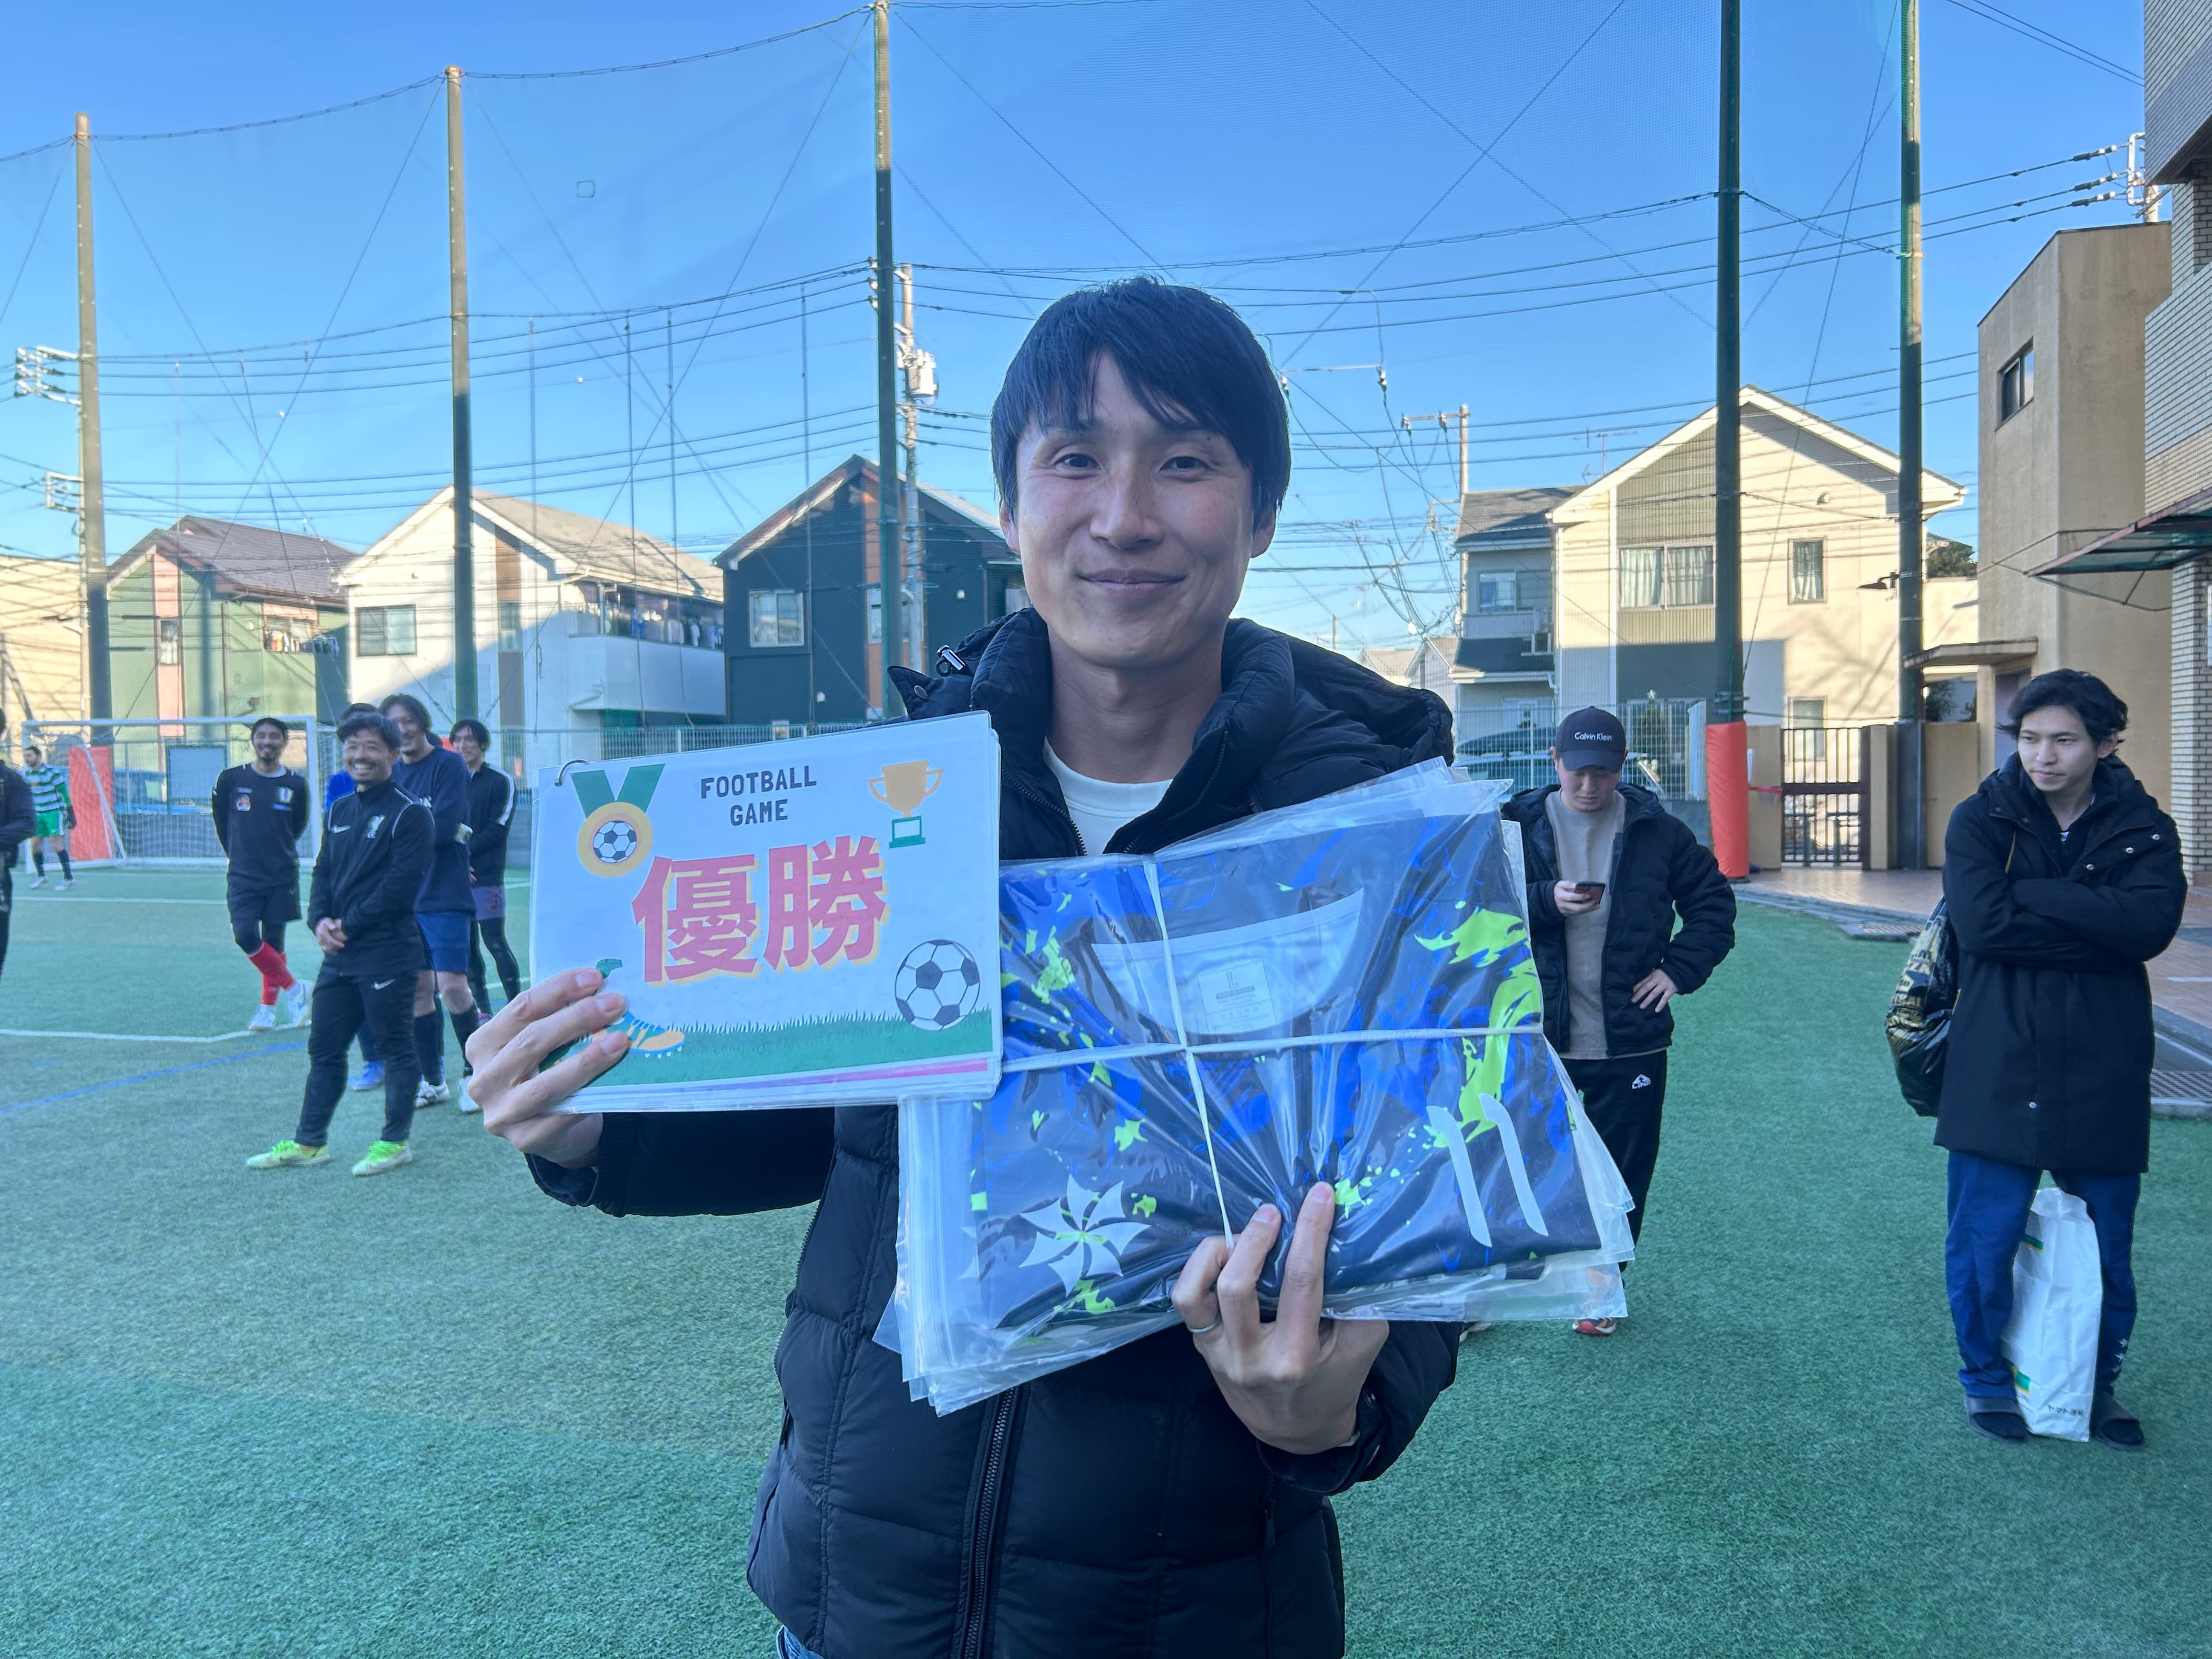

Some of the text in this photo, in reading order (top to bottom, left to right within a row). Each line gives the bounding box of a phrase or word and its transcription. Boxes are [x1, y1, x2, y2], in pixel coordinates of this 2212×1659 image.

[1574, 731, 1612, 742] Calvin Klein
[700, 765, 817, 799] FOOTBALL
[730, 798, 788, 826] GAME
[631, 835, 889, 985] 優勝
[1226, 971, 1238, 988] L
